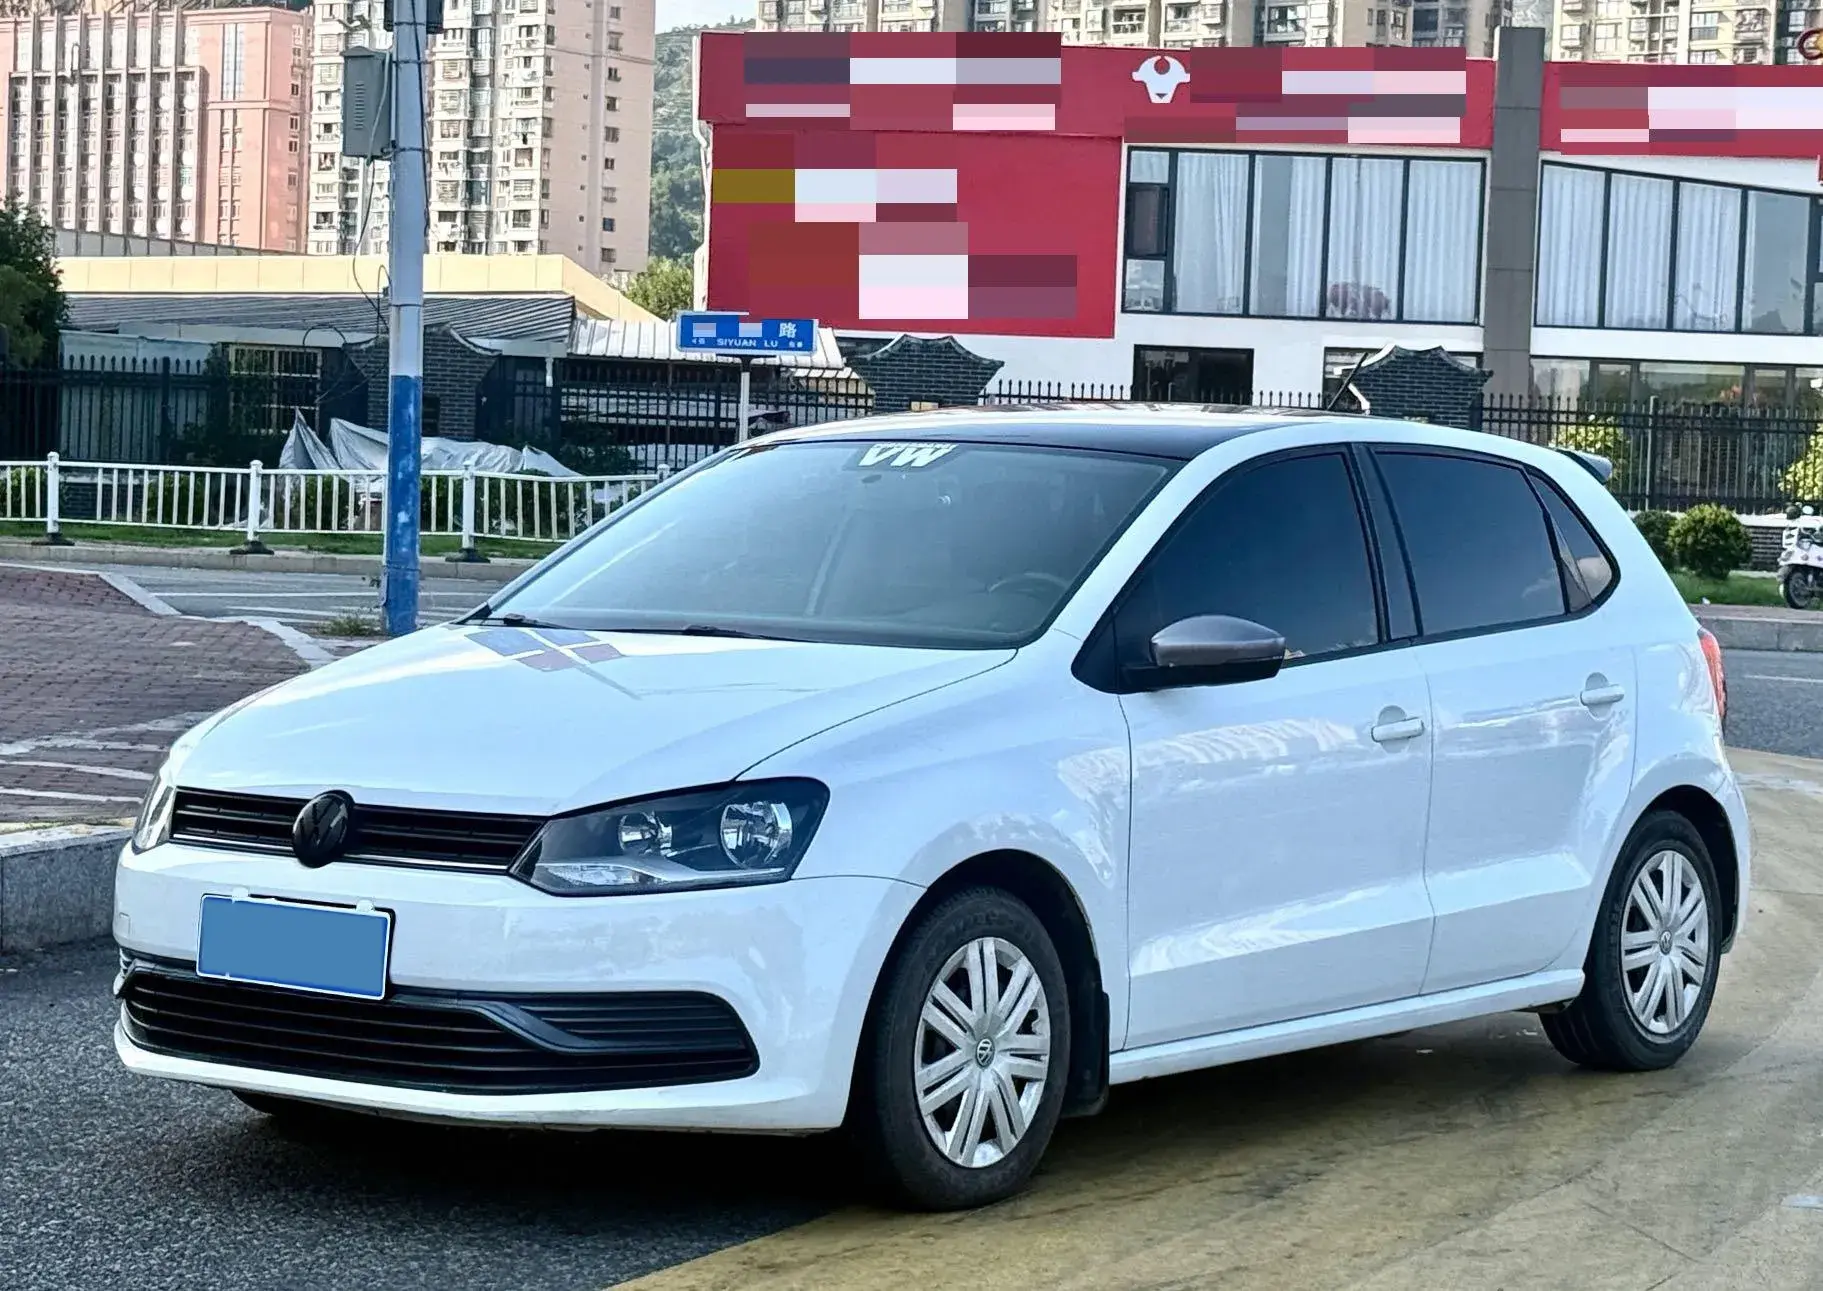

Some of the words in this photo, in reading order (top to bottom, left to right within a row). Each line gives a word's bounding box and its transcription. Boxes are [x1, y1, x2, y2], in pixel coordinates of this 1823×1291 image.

[717, 338, 757, 347] SIYUAN
[764, 340, 778, 348] LU
[858, 443, 960, 467] VW
